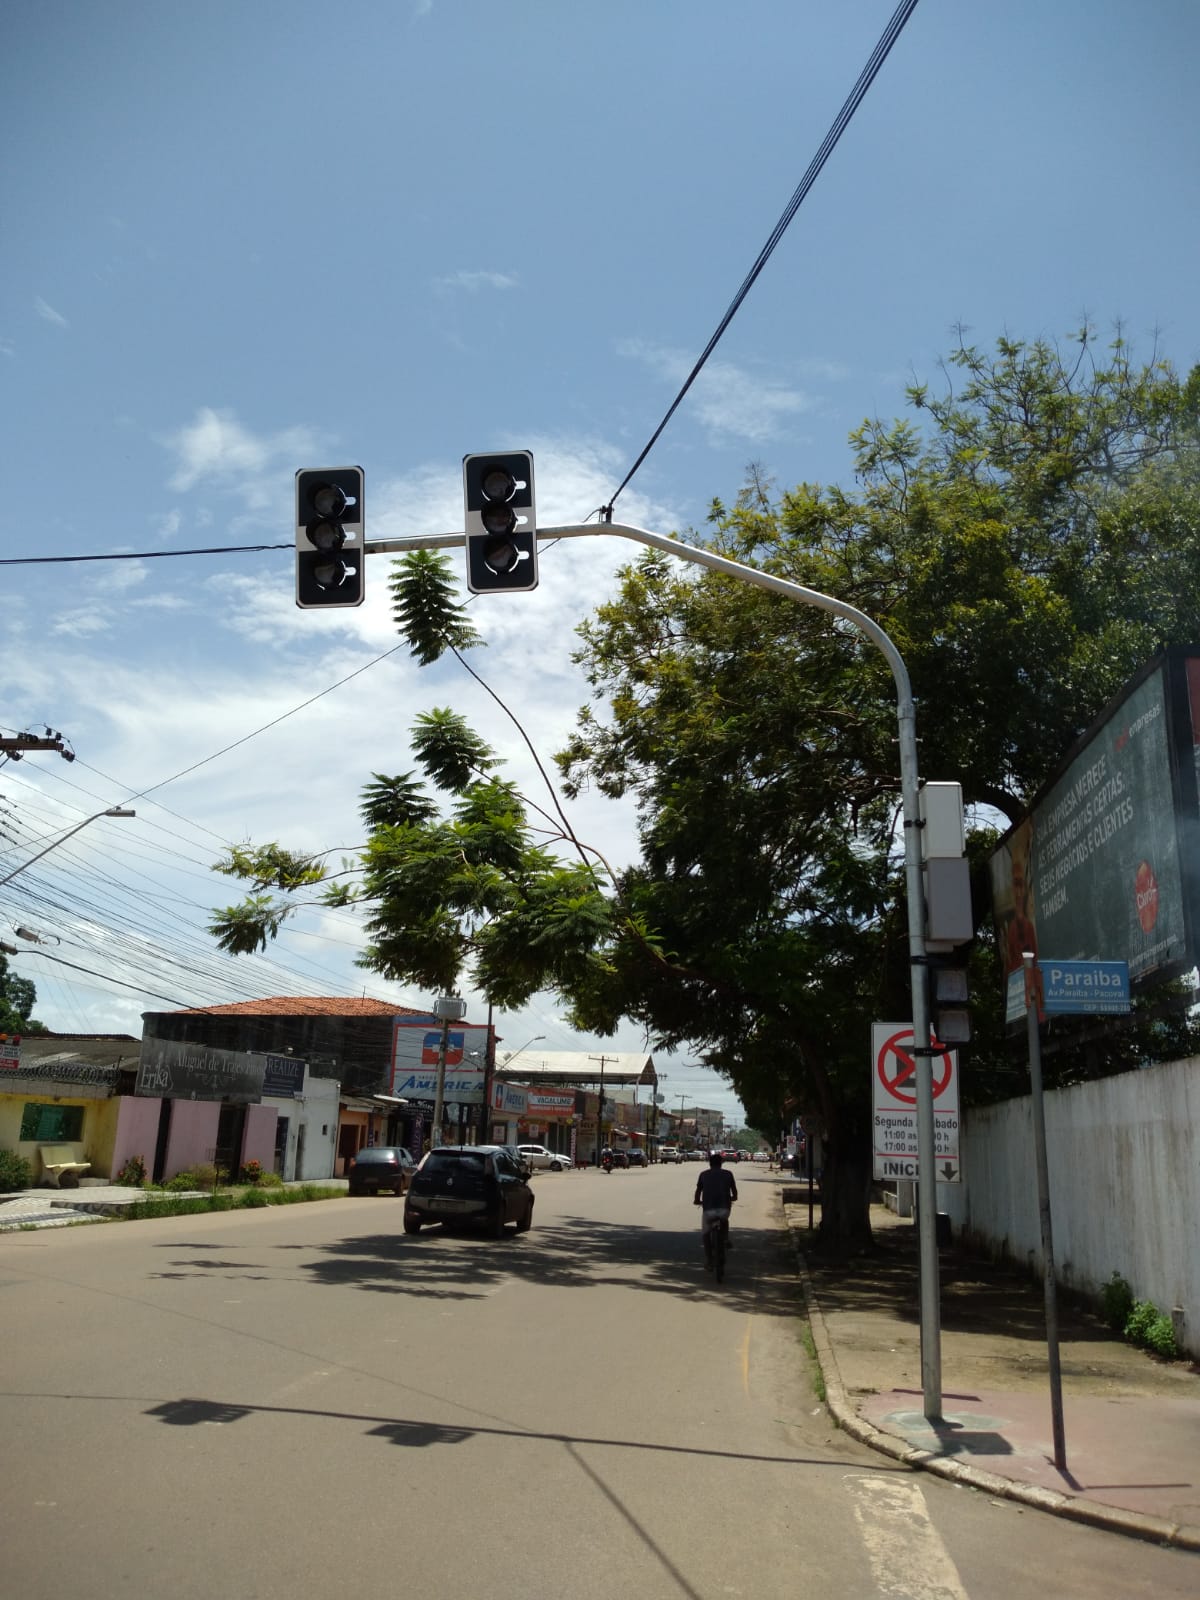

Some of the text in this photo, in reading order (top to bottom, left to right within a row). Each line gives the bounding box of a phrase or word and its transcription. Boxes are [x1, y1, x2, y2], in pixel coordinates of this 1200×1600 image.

[1129, 703, 1161, 737] empresas
[1048, 789, 1078, 833] EMPRESA
[1075, 753, 1106, 803] MERECE
[1038, 771, 1126, 870] AS FERRAMENTAS CERTAS.
[1040, 795, 1134, 896] SEUS NEGÓCIOS E CLIENTES
[1051, 969, 1121, 986] Paraiba
[174, 1050, 208, 1072] Aluguel
[209, 1055, 219, 1071] de
[141, 1060, 168, 1089] Erika
[875, 1116, 958, 1128] Segunda bado
[884, 1130, 906, 1140] 11:00
[943, 1132, 949, 1141] h
[884, 1142, 906, 1152] 17:00
[884, 1161, 919, 1176] INÍCI
